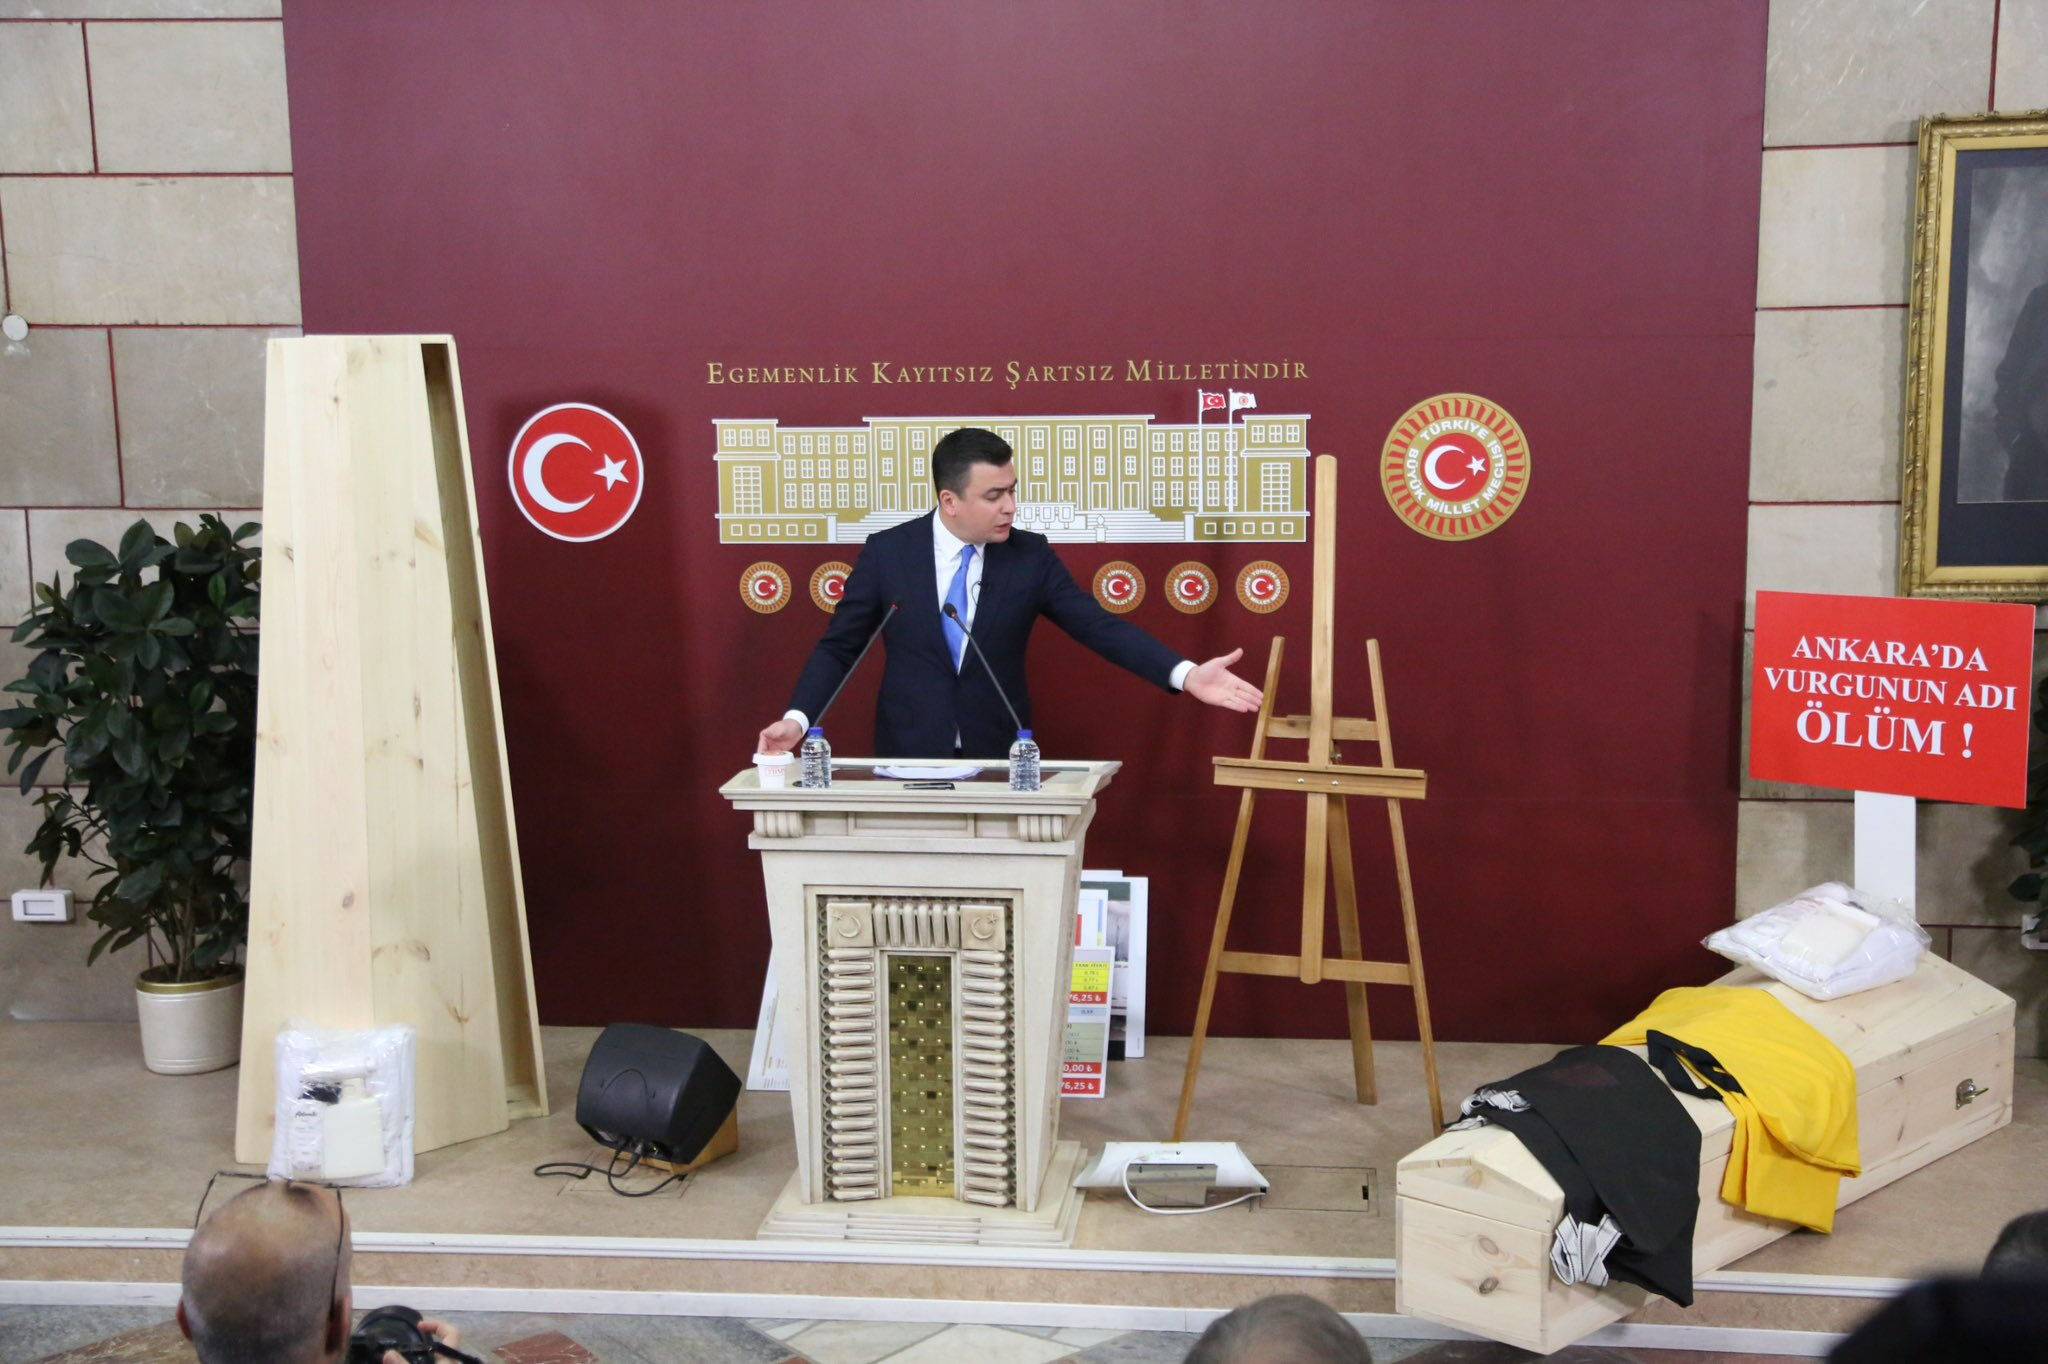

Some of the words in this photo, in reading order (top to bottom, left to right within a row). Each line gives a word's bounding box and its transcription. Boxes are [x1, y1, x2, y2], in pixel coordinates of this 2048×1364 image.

[706, 361, 859, 385] EGEMENLİK
[871, 361, 994, 385] KAYITSIZ
[1005, 359, 1115, 389] ŞARTSIZ
[1420, 419, 1489, 441] TÜRKİYE
[1406, 448, 1427, 501] BÜYÜK
[1426, 497, 1481, 515] MİLLET
[1482, 440, 1505, 501] MECLİSİ
[1792, 635, 1989, 672] ANKARA'DA
[1763, 667, 1948, 705] VURGUNUN
[1954, 683, 2017, 711] ADI
[1796, 700, 1946, 756] ÖLÜM
[1961, 722, 1974, 759] !
